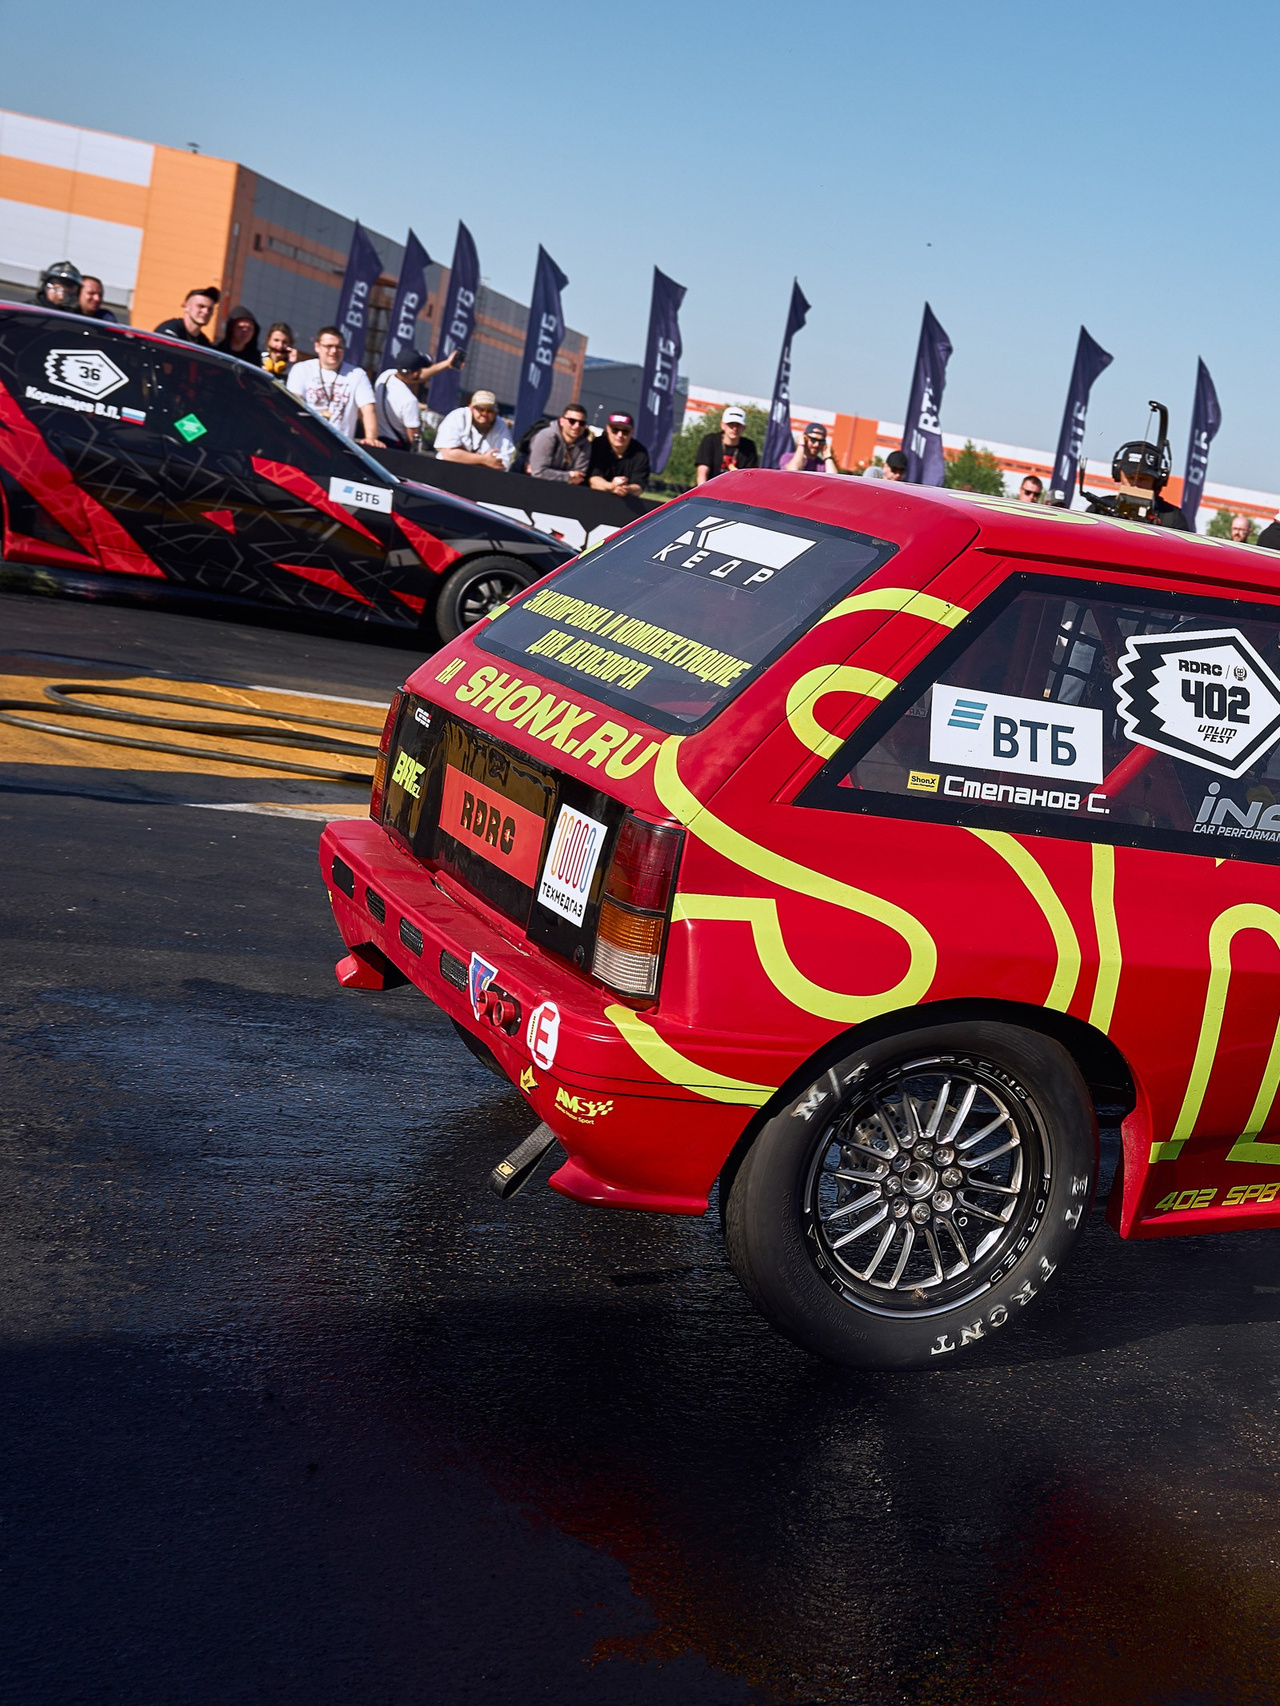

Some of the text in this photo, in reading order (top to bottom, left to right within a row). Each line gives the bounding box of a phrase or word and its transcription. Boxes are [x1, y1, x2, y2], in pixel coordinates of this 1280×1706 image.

[346, 280, 368, 328] ВТБ
[397, 291, 418, 340] ВТБ
[450, 287, 475, 340] ВТБ
[535, 312, 557, 366] ВТБ
[79, 366, 101, 381] 36
[653, 336, 675, 391] ВТБ
[355, 491, 380, 505] ВТБ
[652, 543, 775, 586] КЕДР
[522, 589, 753, 689] ЭКИПИРОВКА И КОМПЛЕКТУЮЩИЕ
[525, 628, 654, 691] ДЛЯ АВТОСПОРТА
[1178, 659, 1223, 677] RDRC
[434, 658, 662, 780] НА SHONX.RU
[1181, 678, 1251, 725] 402
[993, 715, 1077, 767] ВТБ
[1197, 724, 1238, 737] UNLIM
[1203, 734, 1233, 745] FEST
[911, 775, 936, 785] ShonX
[943, 775, 1110, 814] Степанов С.
[460, 791, 515, 855] RDRC
[1192, 823, 1216, 836] CAR
[542, 881, 584, 918] ТЕХМЕДГАЗ
[940, 1056, 1029, 1100] RACING
[1155, 1188, 1218, 1211] 402
[989, 1177, 1050, 1284] FORGED
[930, 1255, 1058, 1356] FRONT
